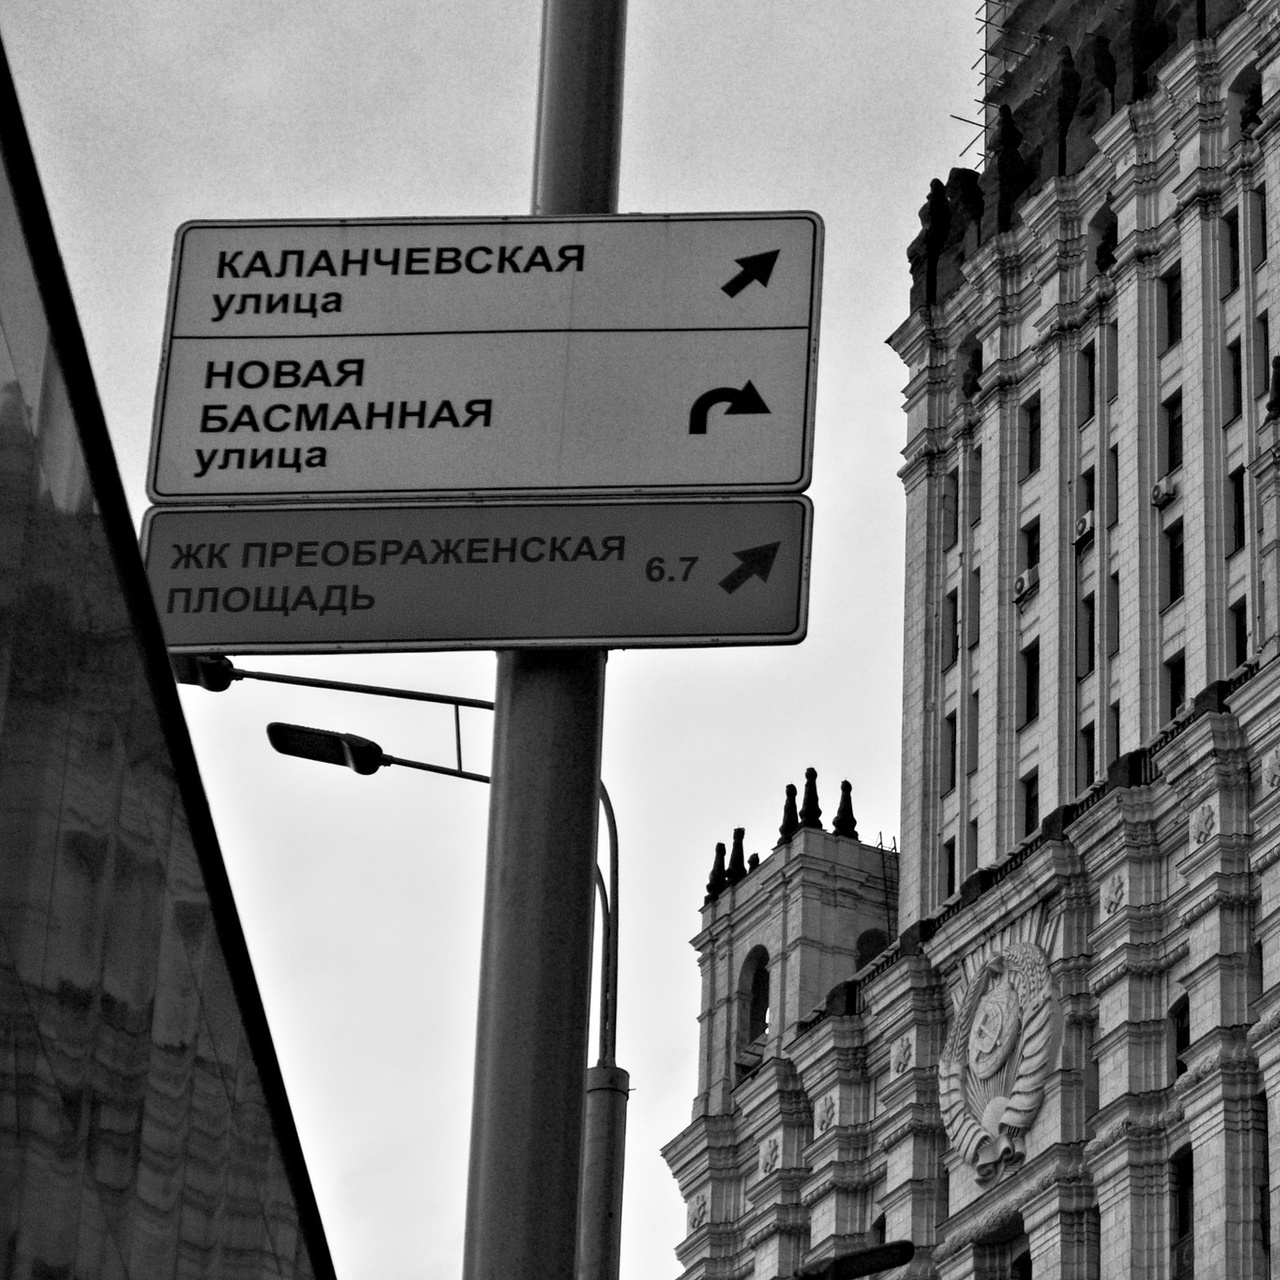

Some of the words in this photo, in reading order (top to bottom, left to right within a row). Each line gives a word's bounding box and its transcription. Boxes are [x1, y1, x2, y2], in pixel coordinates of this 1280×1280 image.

[216, 244, 586, 279] КАЛАНЧЕВСКАЯ
[210, 291, 343, 323] улица
[204, 358, 365, 390] НОВАЯ
[199, 398, 493, 434] БАСМАННАЯ
[193, 446, 328, 478] улица
[170, 542, 230, 570] ЖК
[241, 535, 627, 569] ПРЕОБРАЖЕНСКАЯ
[645, 556, 699, 583] 6.7
[165, 584, 376, 617] ПЛОЩАДЬ
